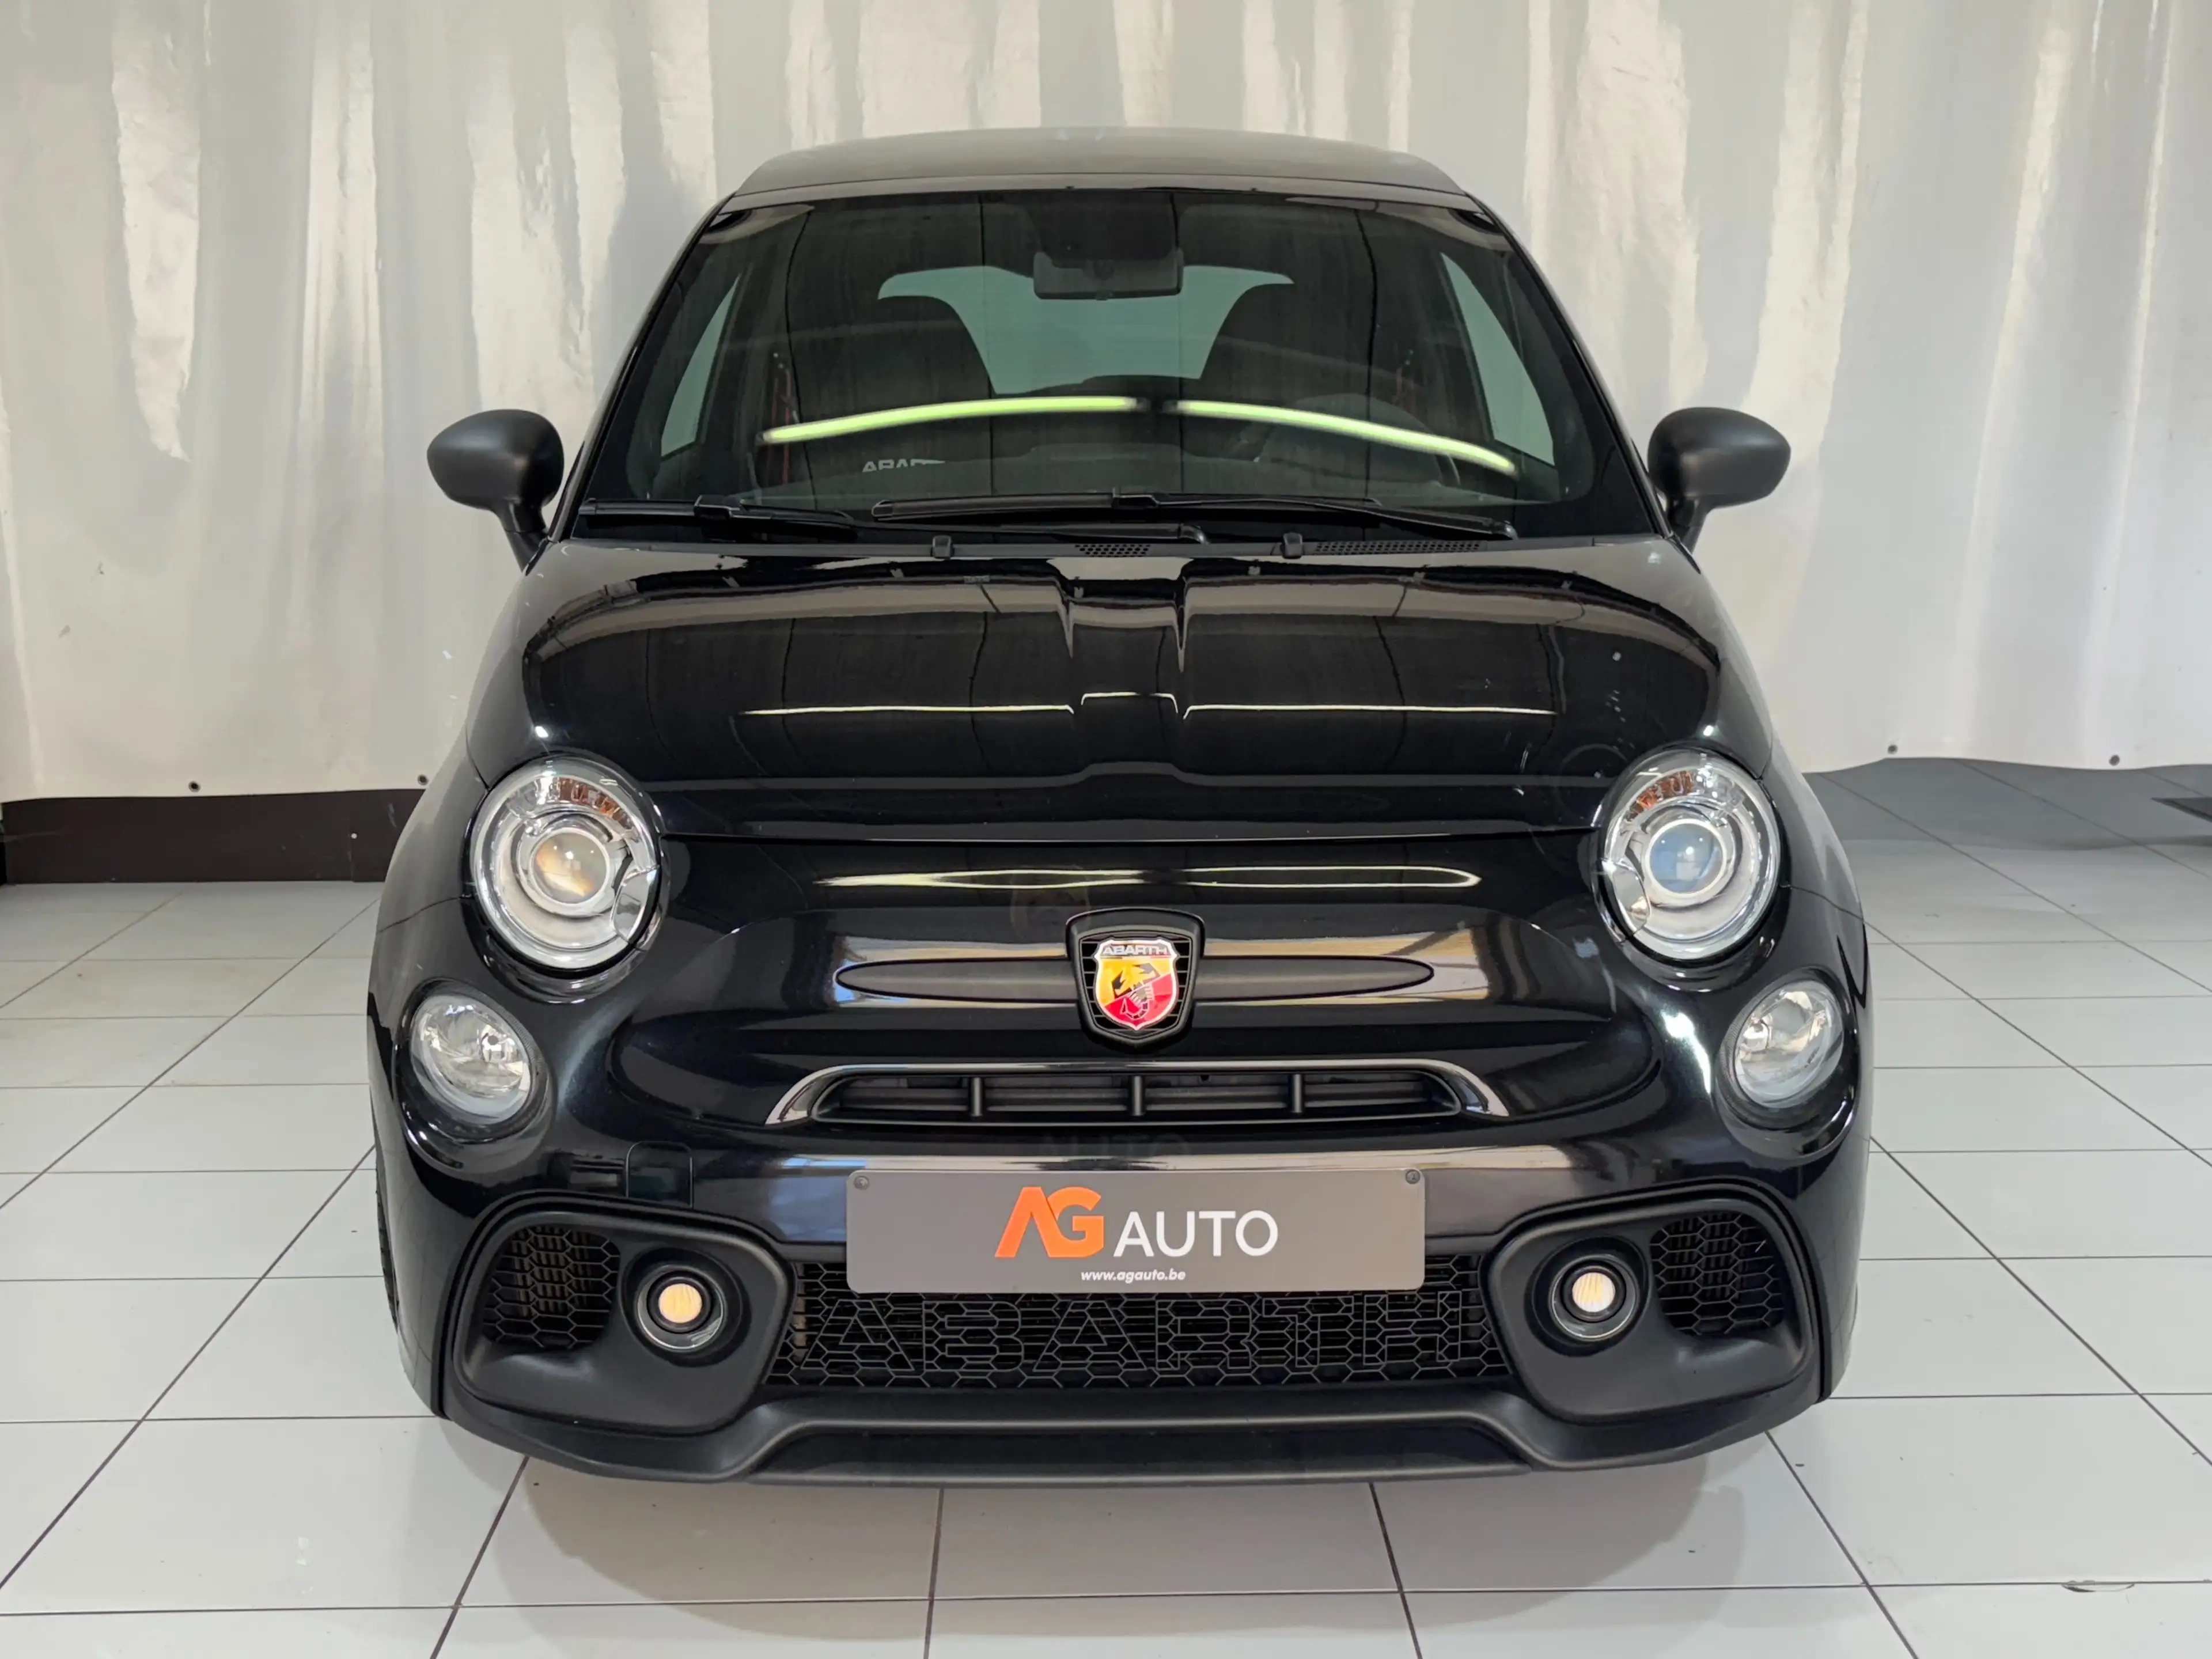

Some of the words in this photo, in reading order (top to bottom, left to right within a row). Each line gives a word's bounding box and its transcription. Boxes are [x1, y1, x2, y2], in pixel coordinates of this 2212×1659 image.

[1103, 944, 1168, 956] ABARTH
[995, 1186, 1105, 1258] AG
[1113, 1210, 1278, 1257] AUTO
[1081, 1268, 1186, 1284] www.agauto.be
[800, 1291, 1461, 1372] ABARTH
